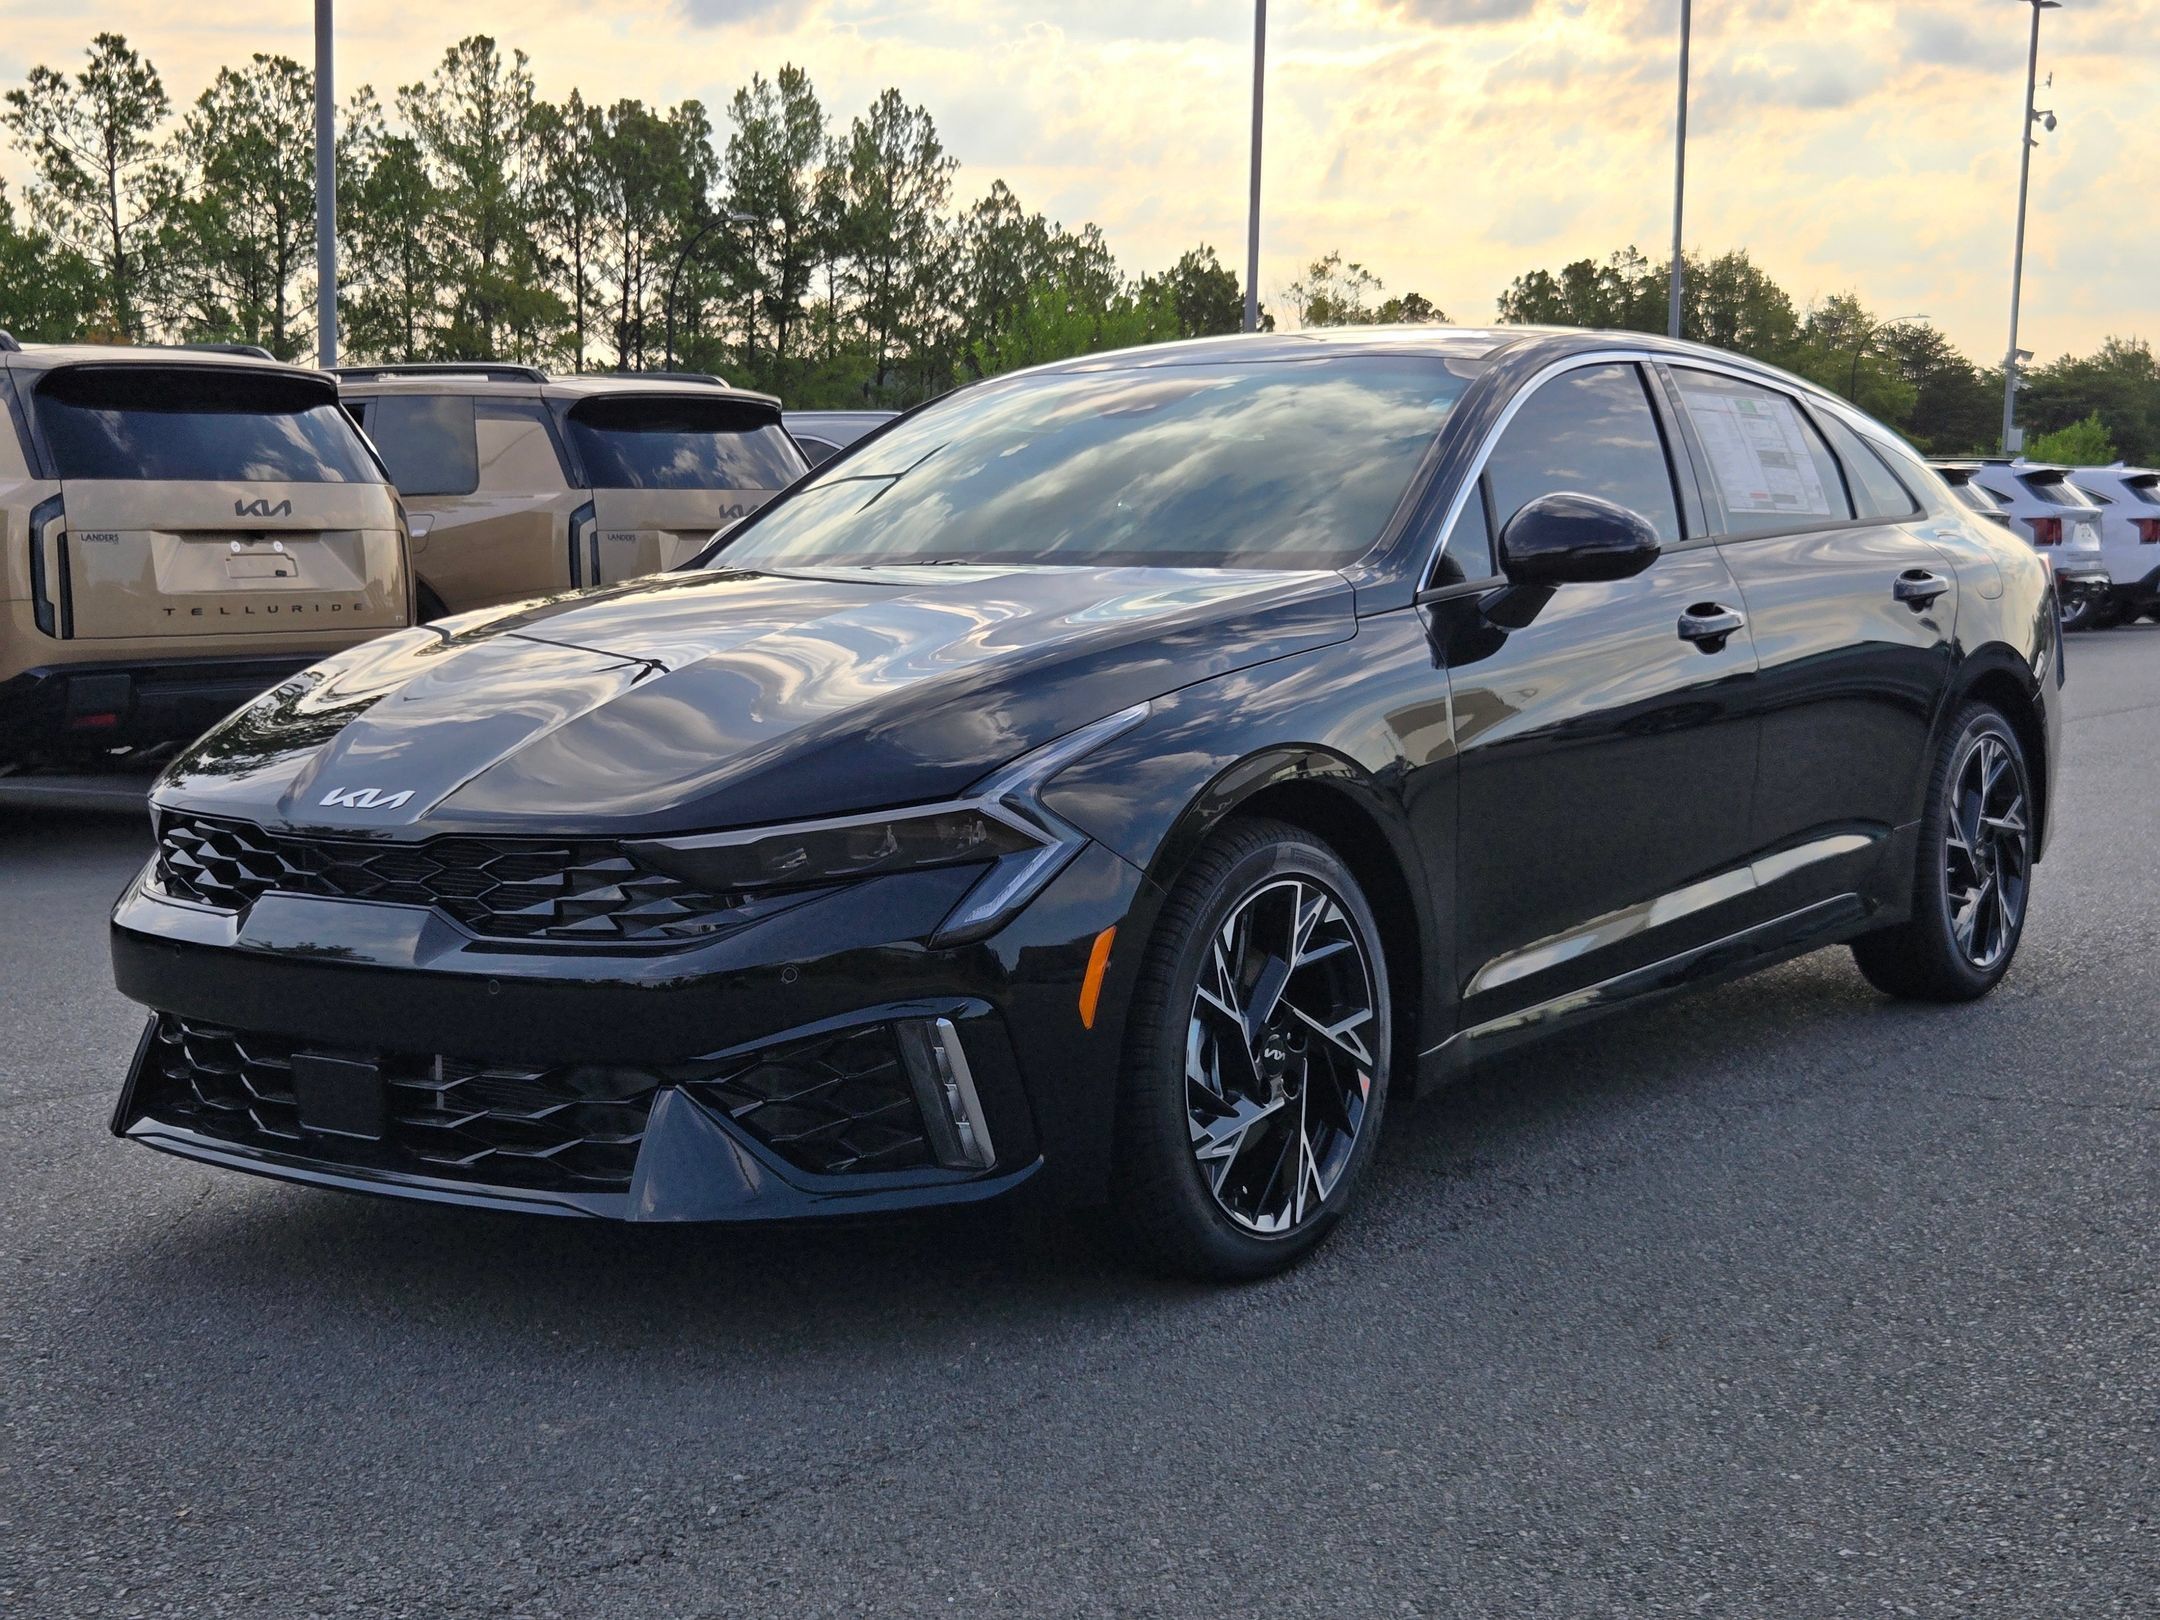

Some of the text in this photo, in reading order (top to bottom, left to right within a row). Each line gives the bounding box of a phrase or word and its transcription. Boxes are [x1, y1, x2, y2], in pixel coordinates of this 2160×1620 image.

[235, 499, 292, 516] KIA
[80, 533, 119, 542] LANDERS
[163, 602, 363, 616] TELLURIDE
[319, 787, 417, 810] KIA
